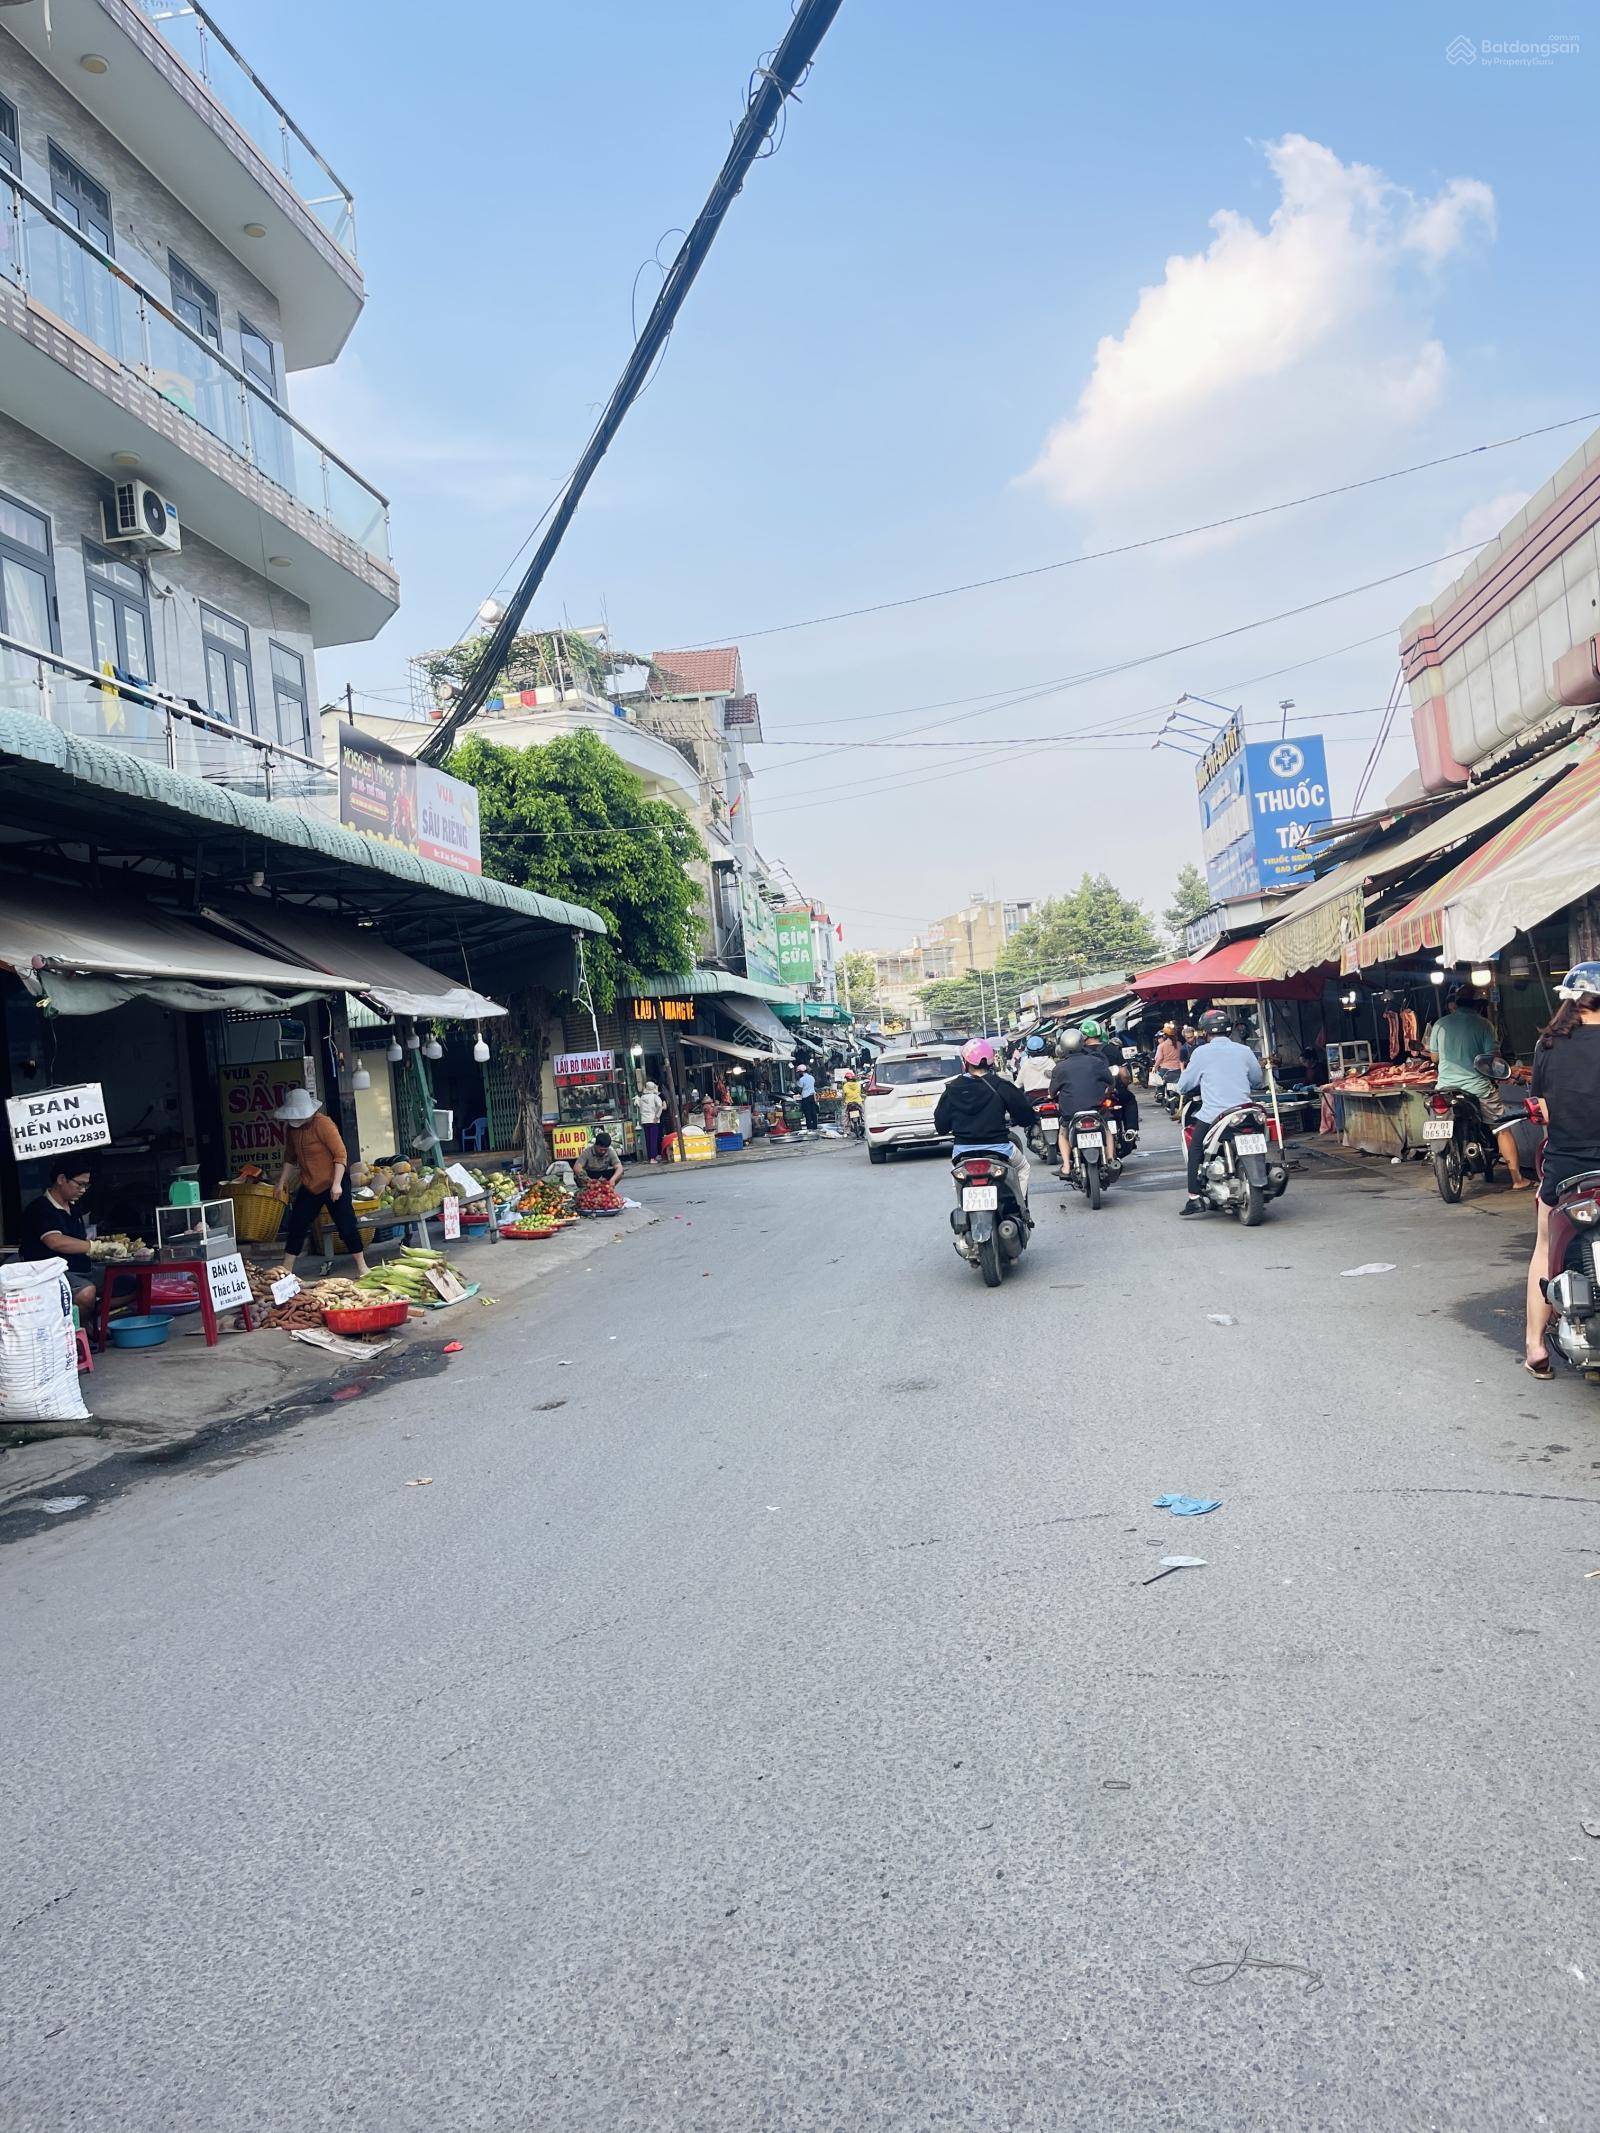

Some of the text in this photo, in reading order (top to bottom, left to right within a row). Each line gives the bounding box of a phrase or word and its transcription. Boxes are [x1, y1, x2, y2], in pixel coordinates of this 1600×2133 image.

[1254, 777, 1325, 814] THUỐC
[779, 926, 809, 946] BỈM
[780, 947, 811, 965] SỮA
[581, 1057, 601, 1072] MANG
[29, 1096, 80, 1117] BÁN
[14, 1113, 106, 1139] HẾN NÓNG
[229, 1112, 288, 1151] RIÊN
[574, 1129, 586, 1143] BÒ
[18, 1130, 107, 1154] LH: 0972042839
[556, 1147, 576, 1159] MANG
[212, 1283, 232, 1299] Thác
